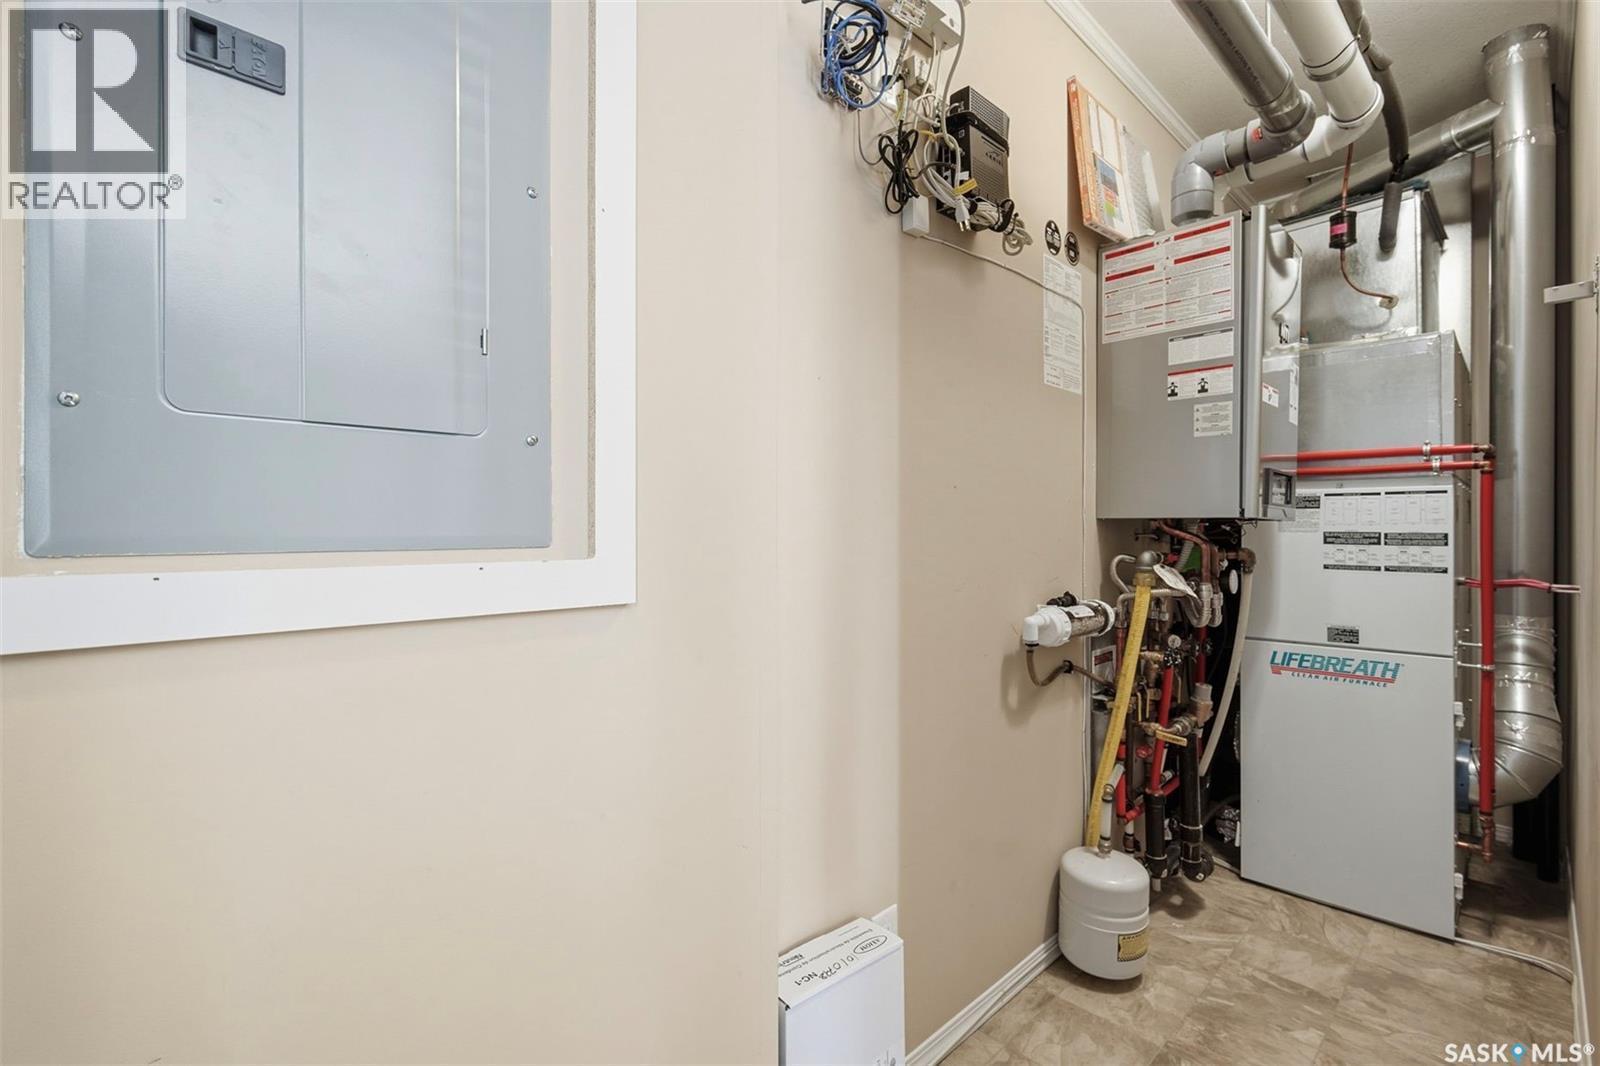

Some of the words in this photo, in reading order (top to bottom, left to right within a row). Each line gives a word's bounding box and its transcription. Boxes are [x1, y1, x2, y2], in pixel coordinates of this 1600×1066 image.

[1291, 672, 1319, 680] CLEAN
[1342, 678, 1388, 688] FURNACE
[794, 971, 818, 986] NC-1
